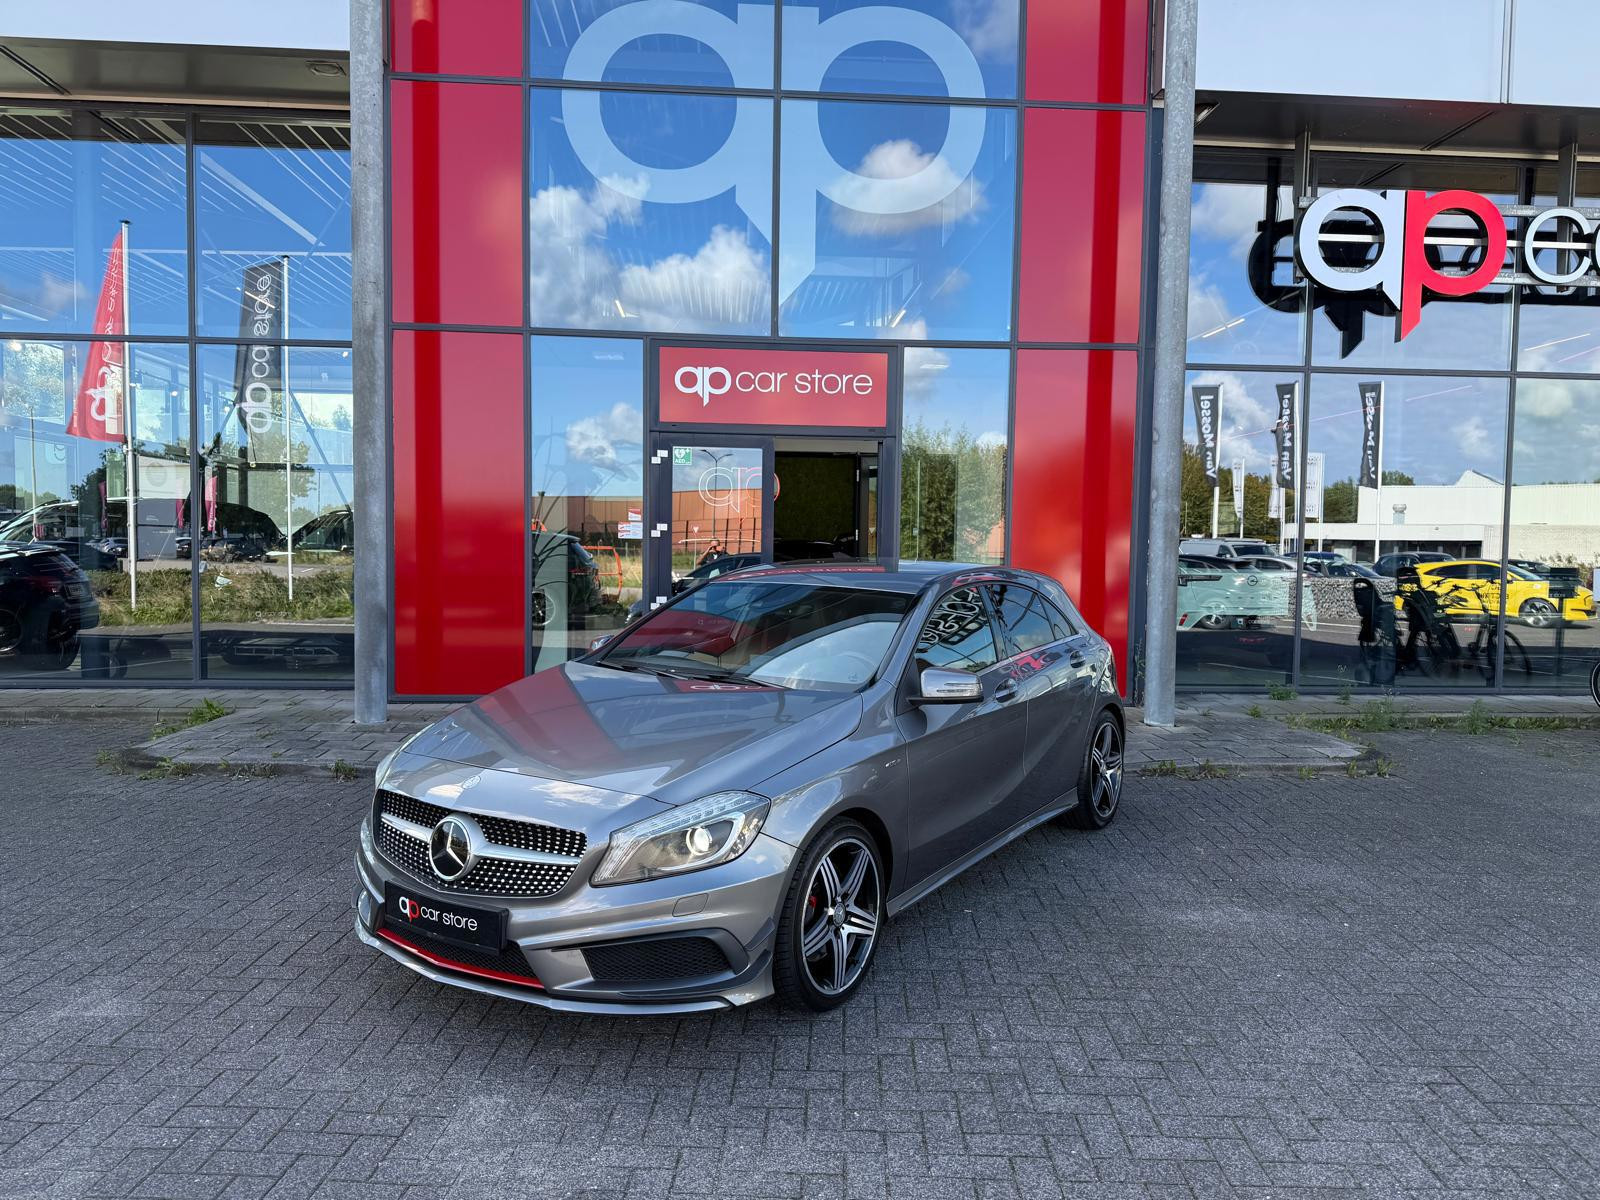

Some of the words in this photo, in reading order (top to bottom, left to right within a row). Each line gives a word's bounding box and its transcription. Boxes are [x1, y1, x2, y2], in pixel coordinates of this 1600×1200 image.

[1299, 188, 1507, 341] ap
[1524, 208, 1600, 284] c
[674, 366, 732, 407] ap
[735, 371, 788, 393] car
[794, 369, 873, 395] store
[399, 896, 420, 927] ap
[420, 906, 441, 922] car
[442, 911, 478, 931] store
